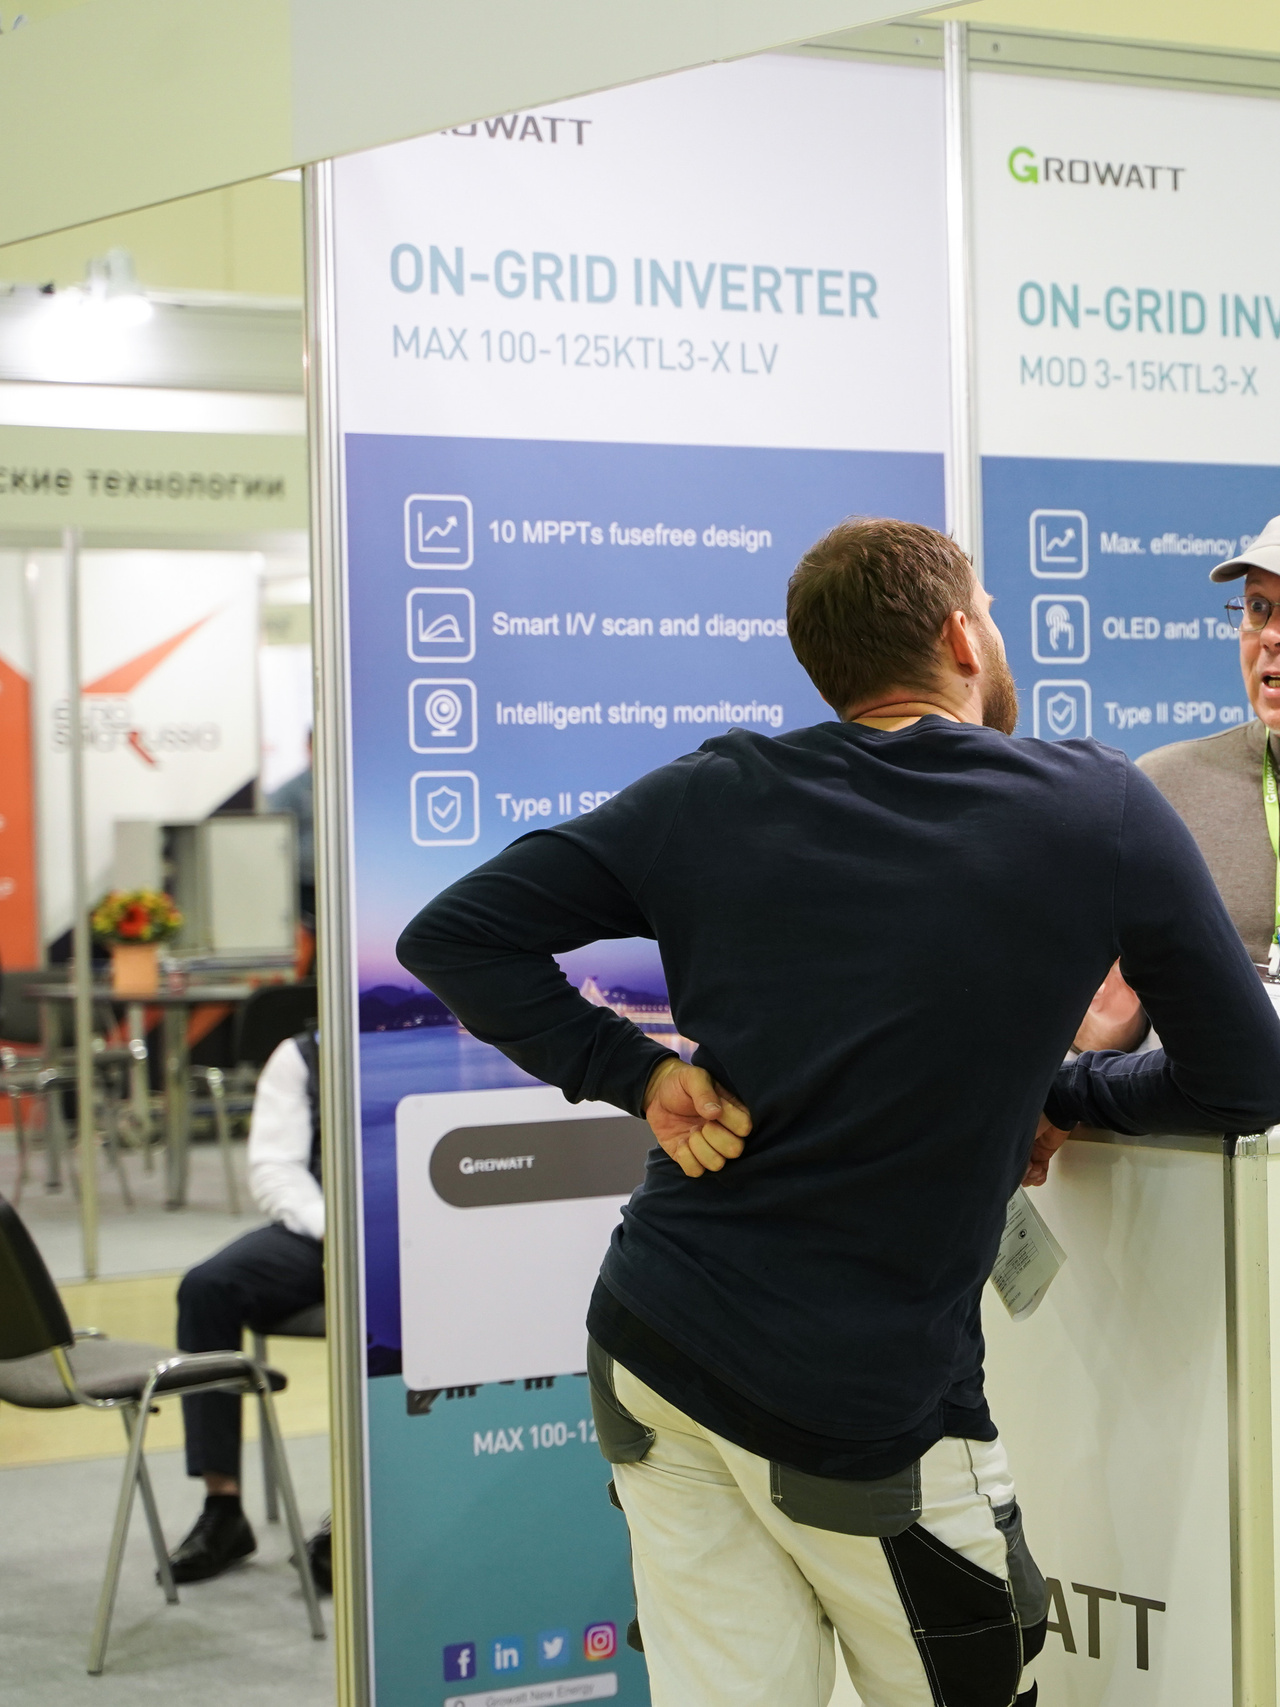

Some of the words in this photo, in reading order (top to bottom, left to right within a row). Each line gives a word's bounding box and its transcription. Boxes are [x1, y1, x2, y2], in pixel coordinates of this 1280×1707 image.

[1008, 146, 1187, 191] GROWATT
[389, 242, 618, 304] ON-GRID
[633, 257, 879, 319] INVERTER
[1017, 281, 1206, 336] ON-GRID
[392, 324, 469, 361] MAX
[480, 329, 731, 373] 100-125KTL3-X
[740, 343, 779, 375] LV
[1020, 355, 1087, 389] MOD
[1094, 359, 1259, 396] 3-15KTL3-X
[86, 468, 286, 501] технологии
[488, 520, 516, 544] 10
[523, 521, 604, 545] MPPTs
[609, 523, 696, 547] fusefree
[702, 525, 772, 554] design
[1099, 532, 1147, 555] Max.
[1150, 533, 1237, 559] efficiency
[492, 611, 560, 636] Smart
[566, 612, 596, 636] I/V
[601, 615, 654, 637] scan
[659, 614, 700, 637] and
[1103, 617, 1160, 640] OLED
[1164, 617, 1200, 640] and
[496, 701, 602, 730] Intelligent
[608, 702, 668, 729] string
[673, 700, 784, 728] monitoring
[1104, 702, 1152, 729] Type
[1173, 701, 1216, 724] SPD
[1219, 706, 1244, 724] on
[496, 793, 552, 822] Type
[459, 1155, 536, 1175] GROWATT
[474, 1427, 524, 1456] MAX
